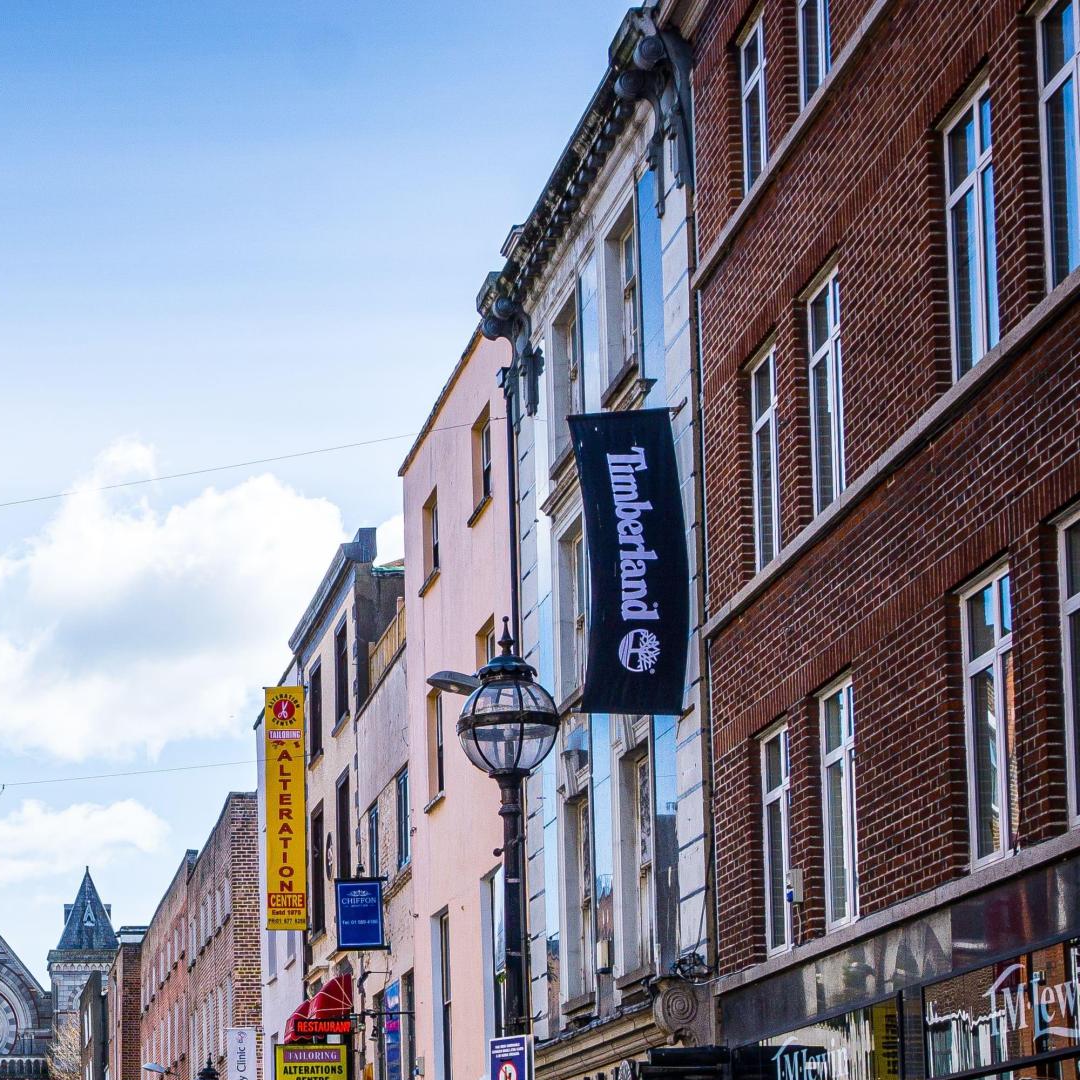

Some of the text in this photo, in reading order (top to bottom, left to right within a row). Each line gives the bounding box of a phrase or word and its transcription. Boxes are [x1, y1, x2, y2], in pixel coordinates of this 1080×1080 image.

[606, 446, 659, 622] Timberland
[270, 730, 301, 739] TAILORING
[278, 750, 294, 892] ALTERATION
[270, 894, 303, 908] CENTRE
[342, 897, 376, 905] CHIFFON
[237, 1046, 247, 1073] Clinic
[288, 1051, 337, 1060] TAILORING
[283, 1065, 343, 1075] ALTERATIONS
